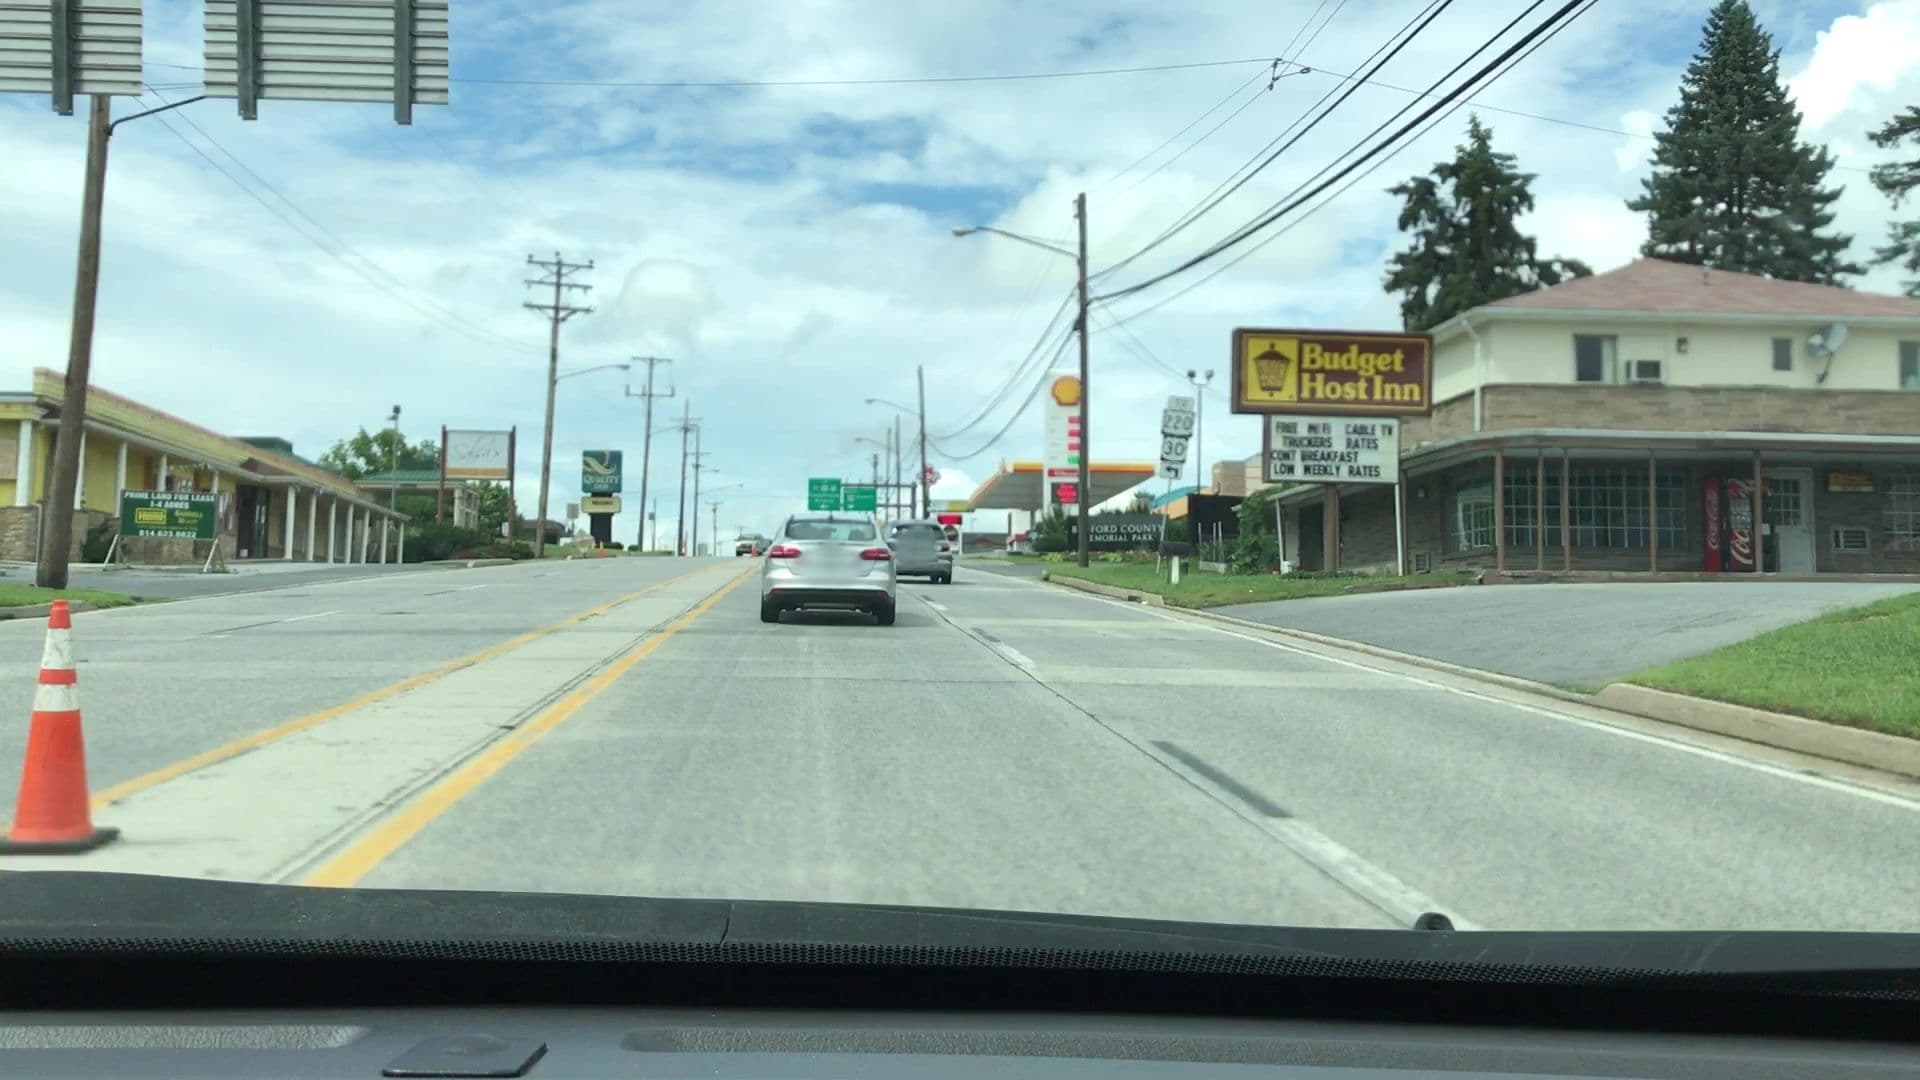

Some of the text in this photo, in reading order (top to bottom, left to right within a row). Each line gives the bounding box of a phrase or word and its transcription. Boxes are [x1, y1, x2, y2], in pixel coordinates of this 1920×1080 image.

[1301, 342, 1405, 377] Budget
[1301, 372, 1422, 401] Host Inn
[1165, 413, 1193, 431] 220
[1276, 421, 1297, 434] FREE
[1162, 440, 1186, 457] 30
[1282, 435, 1378, 450] TRUCKERS RATES
[1301, 450, 1358, 463] BREAKFAST
[1274, 463, 1380, 477] LOW WEEKLY RATES
[151, 492, 173, 500] LAND
[1120, 524, 1163, 534] COUNTY
[1088, 533, 1154, 542] EMORIAL PARK
